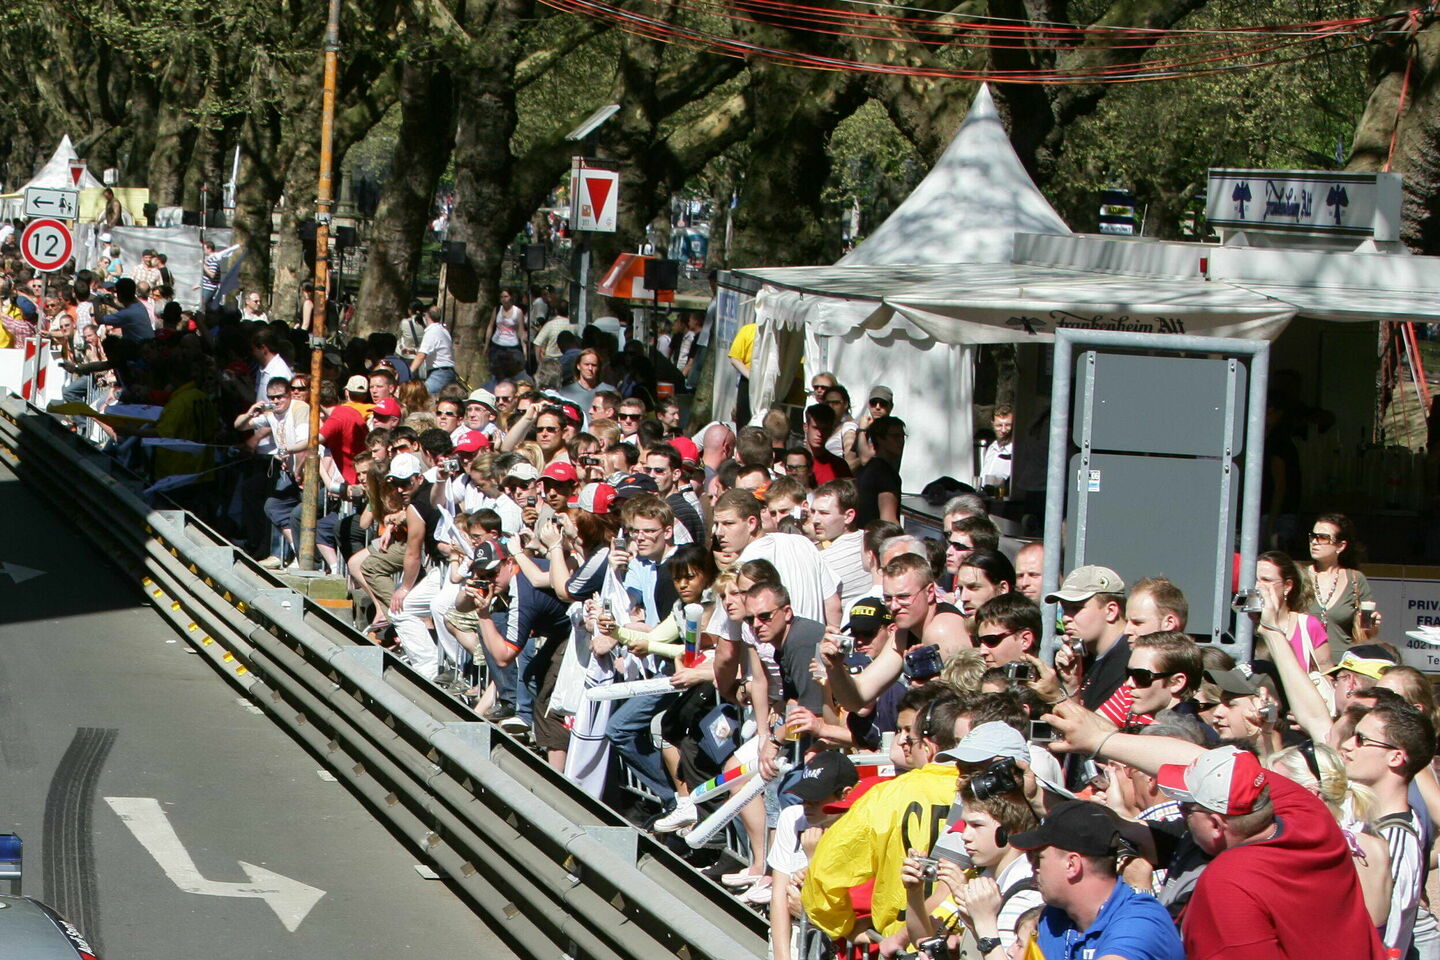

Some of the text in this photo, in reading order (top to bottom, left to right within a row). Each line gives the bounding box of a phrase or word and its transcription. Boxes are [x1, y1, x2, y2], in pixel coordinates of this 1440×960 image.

[33, 233, 59, 257] 12
[1155, 316, 1186, 335] Alt
[1408, 600, 1440, 610] PRIV
